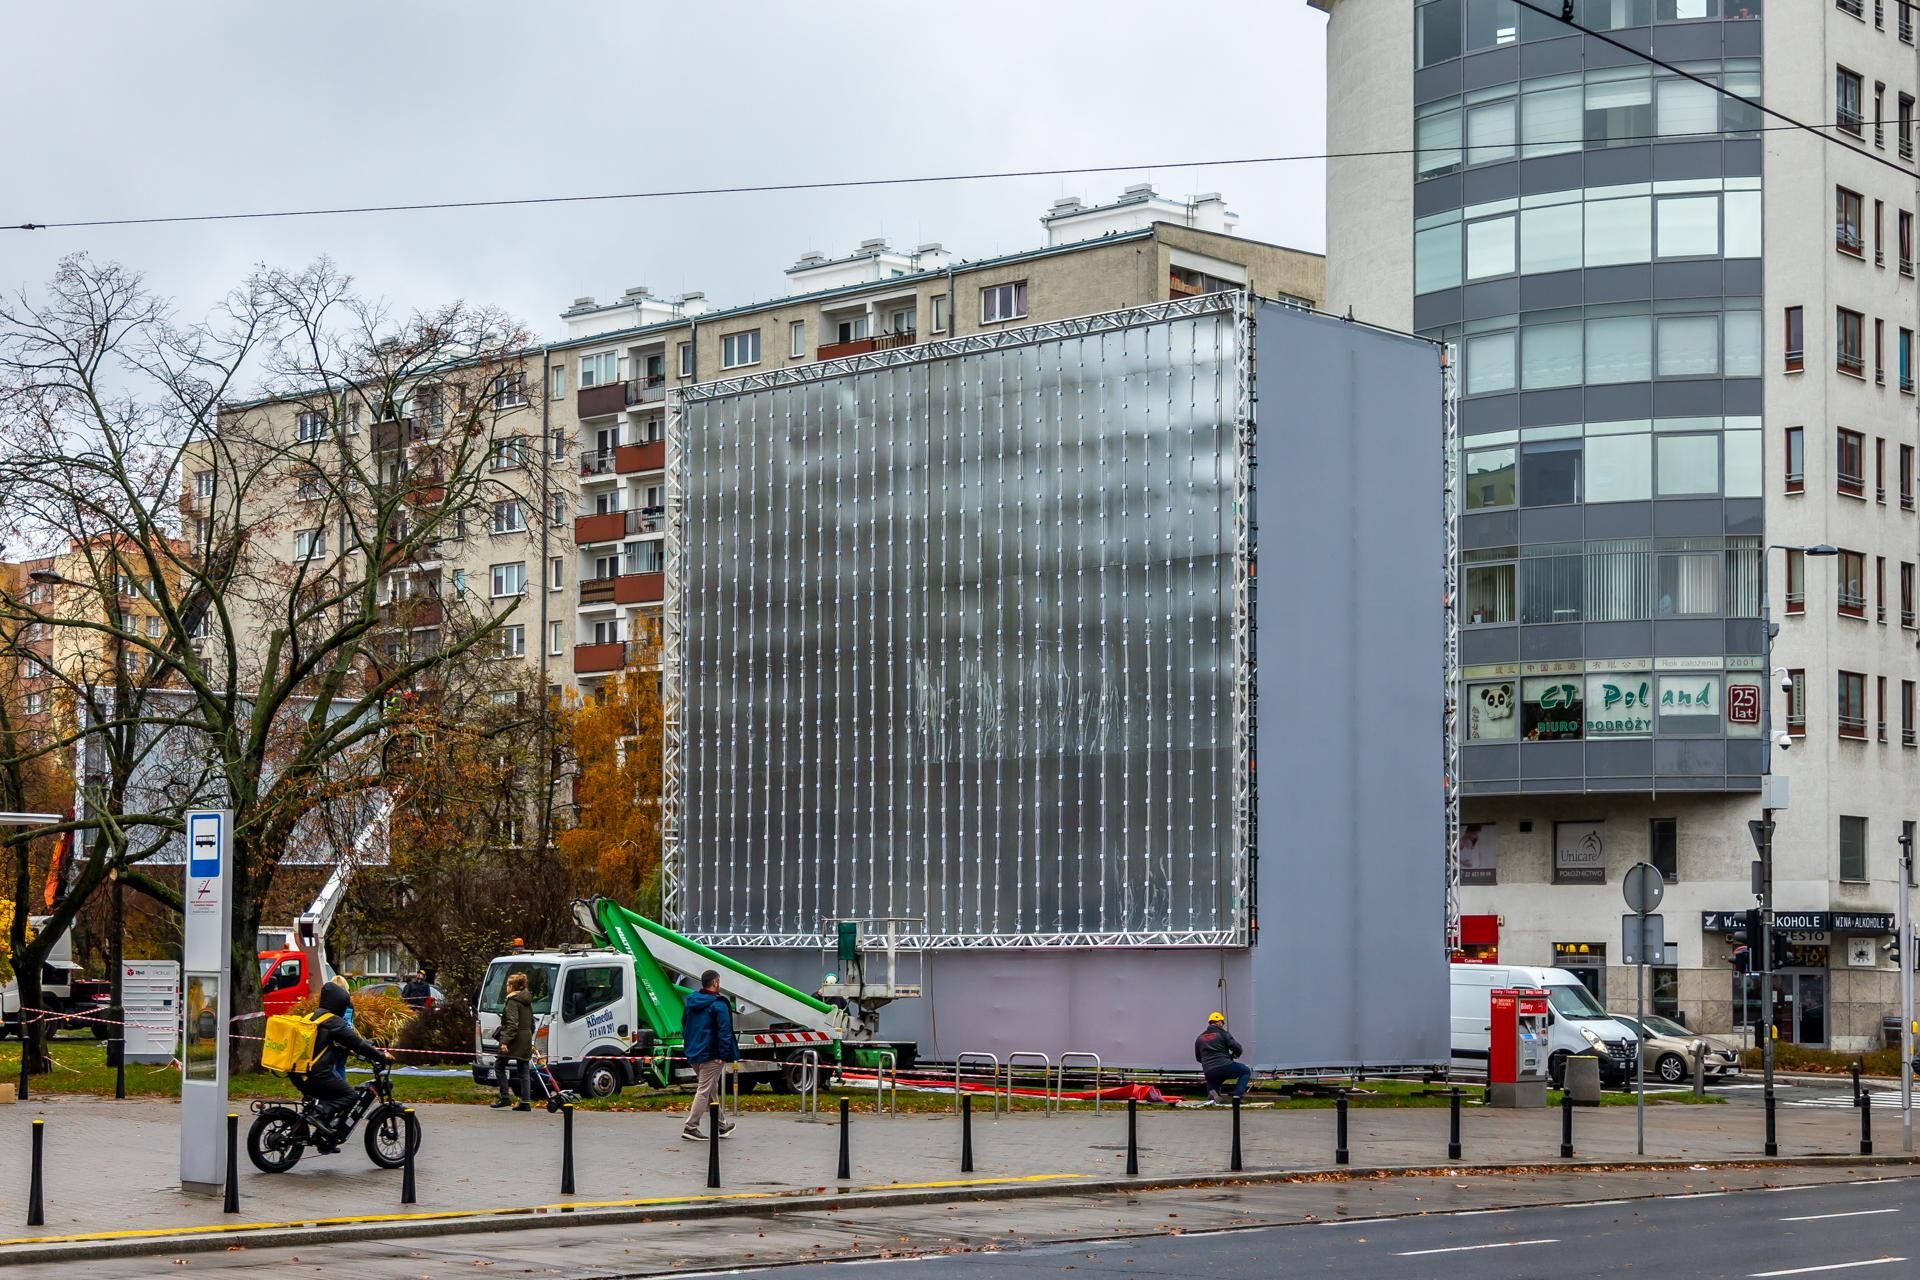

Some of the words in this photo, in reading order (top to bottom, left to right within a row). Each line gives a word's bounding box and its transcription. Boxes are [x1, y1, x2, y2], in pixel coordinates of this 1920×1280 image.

[1730, 658, 1754, 667] 2001
[1733, 689, 1755, 705] 25
[1735, 707, 1754, 719] lat
[1537, 721, 1578, 733] BIURO
[1586, 716, 1651, 732] PODRÓŻY
[1560, 849, 1598, 862] Unicare
[1835, 916, 1851, 928] WINA
[1855, 917, 1885, 928] ALKOHOLE
[1520, 1002, 1533, 1011] Bilety
[585, 1008, 614, 1029] RBmedia
